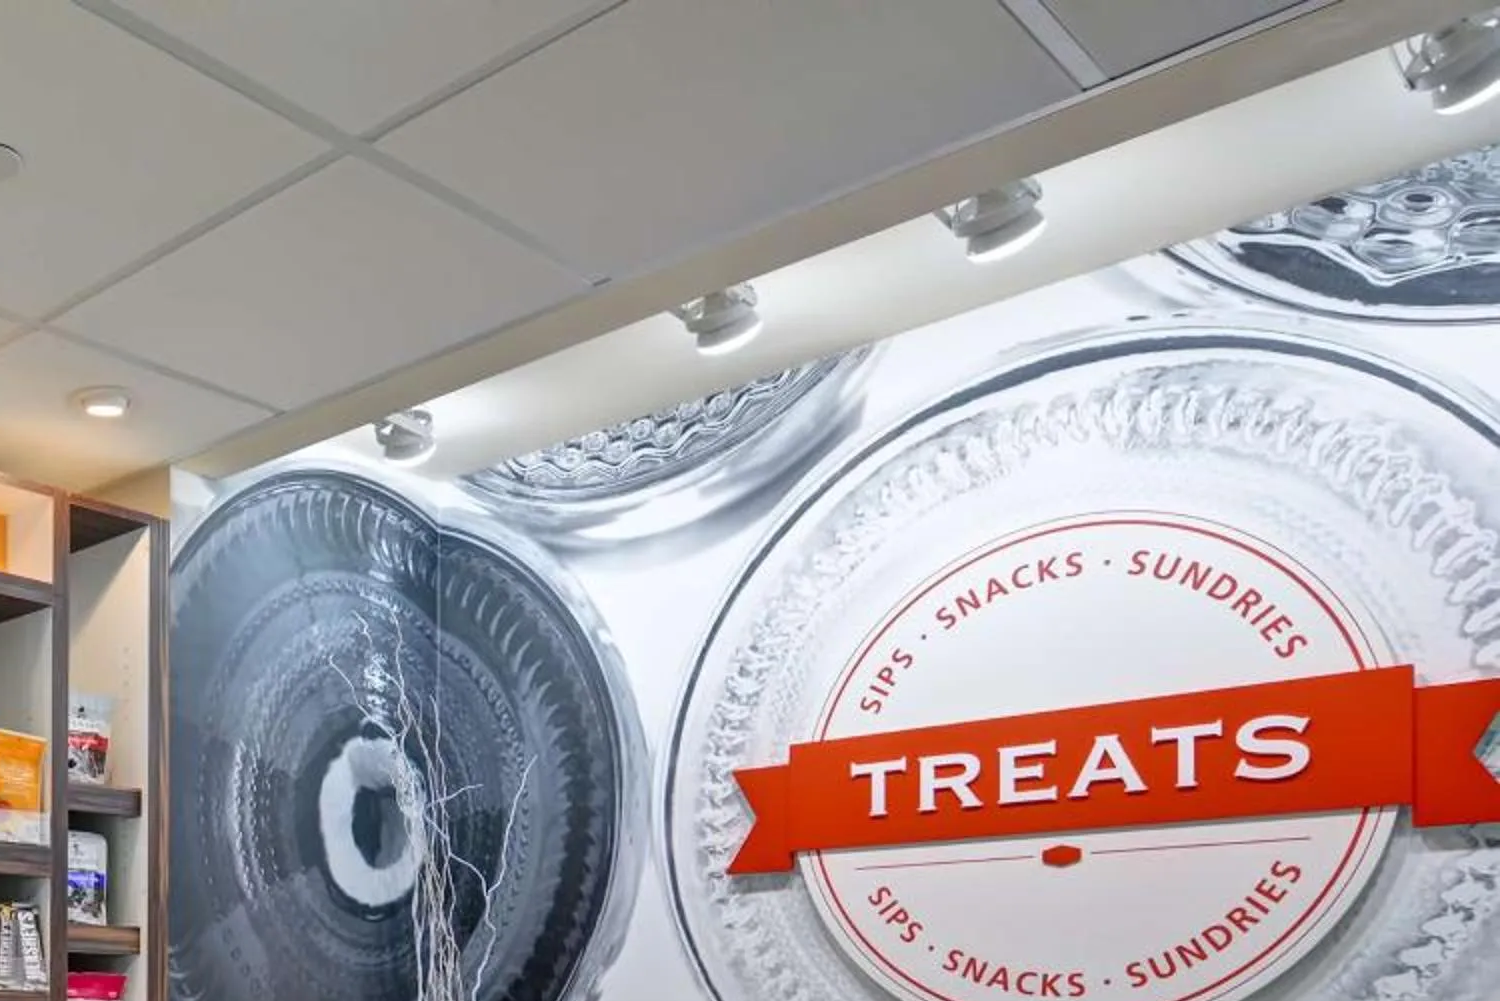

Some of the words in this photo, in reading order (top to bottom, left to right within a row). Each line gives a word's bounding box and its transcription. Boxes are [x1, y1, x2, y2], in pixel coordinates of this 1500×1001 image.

[859, 646, 915, 717] SIPS
[935, 549, 1086, 632] SNACKS
[1128, 547, 1309, 662] SUNDRIES
[850, 713, 1315, 819] TREATS
[867, 885, 924, 945] SIPS
[941, 948, 1086, 999] SNACKS
[1126, 859, 1303, 990] SUNDRIES
